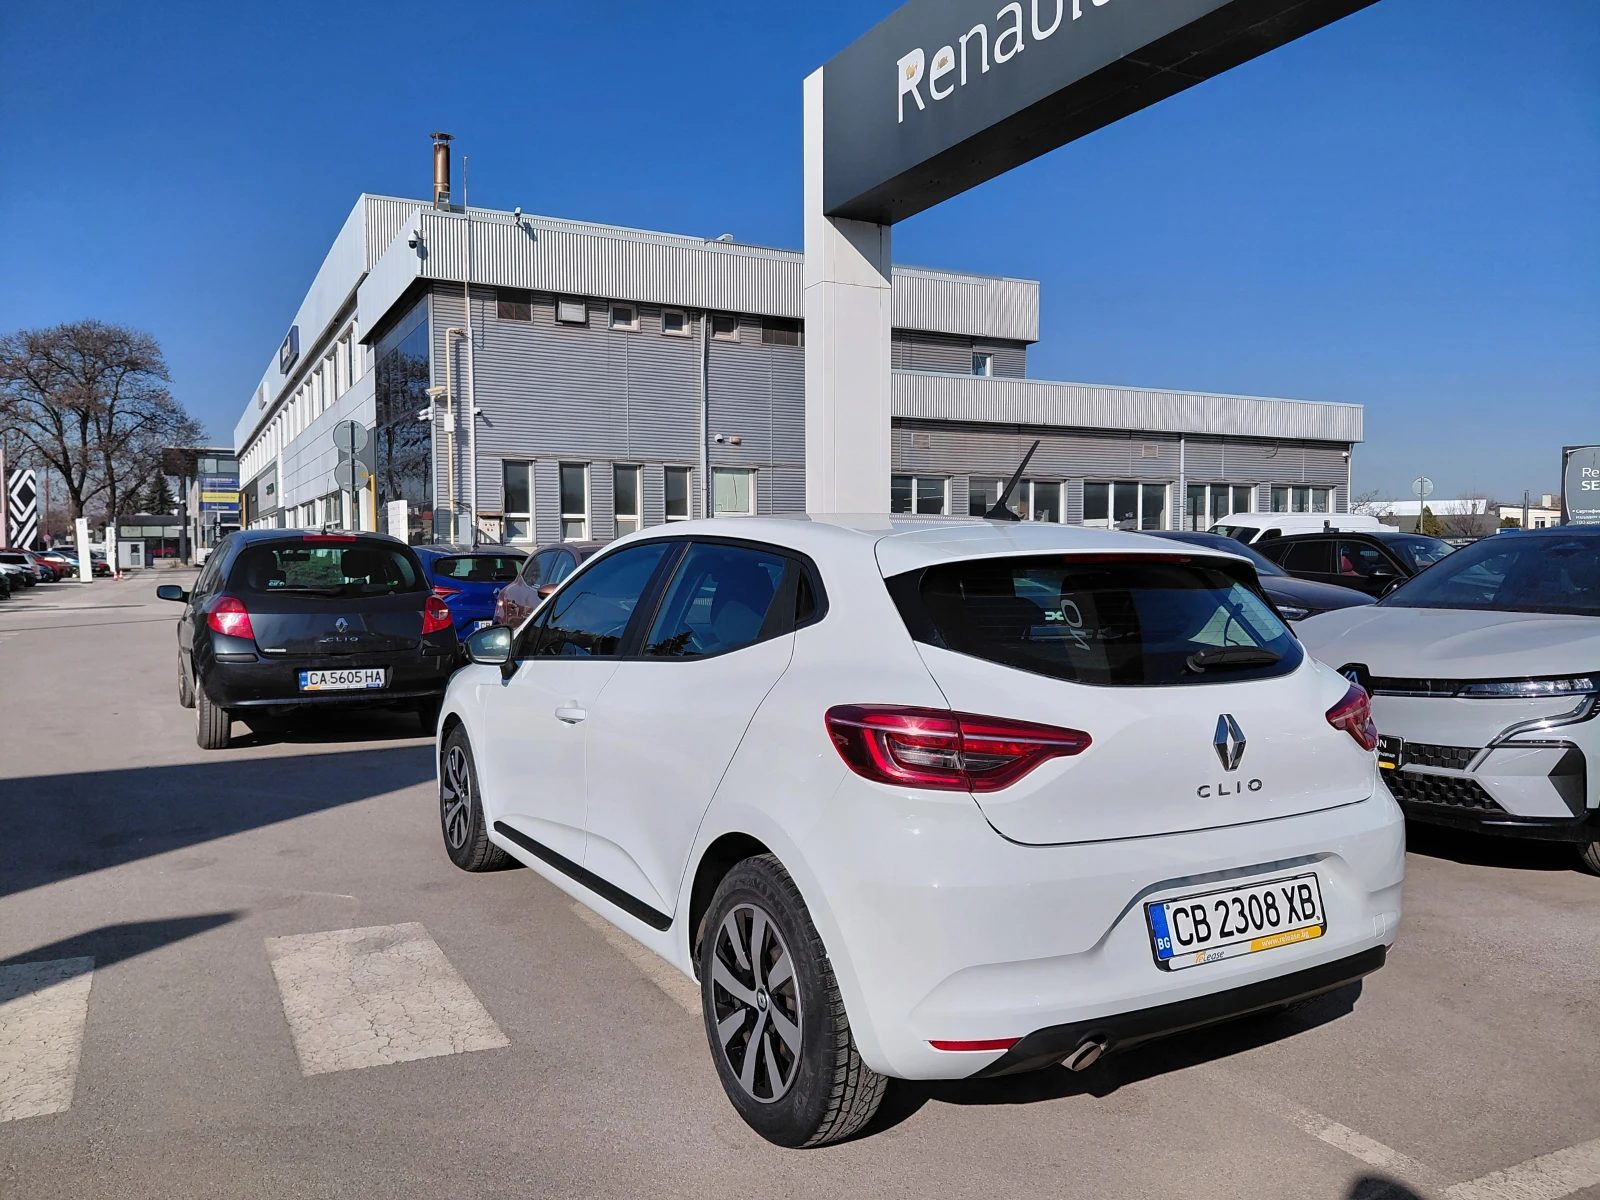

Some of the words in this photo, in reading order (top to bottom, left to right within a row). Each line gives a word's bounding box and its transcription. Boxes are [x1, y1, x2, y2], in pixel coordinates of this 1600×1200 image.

[1581, 480, 1600, 491] SE
[309, 672, 328, 685] CA
[330, 671, 363, 685] 5605
[365, 670, 382, 683] HA
[1197, 779, 1263, 798] CLIO
[1172, 904, 1212, 946] CB
[1214, 891, 1281, 938] 2308
[1281, 884, 1316, 924] XB
[1157, 937, 1171, 950] BG
[1261, 930, 1310, 947] www.release.bg
